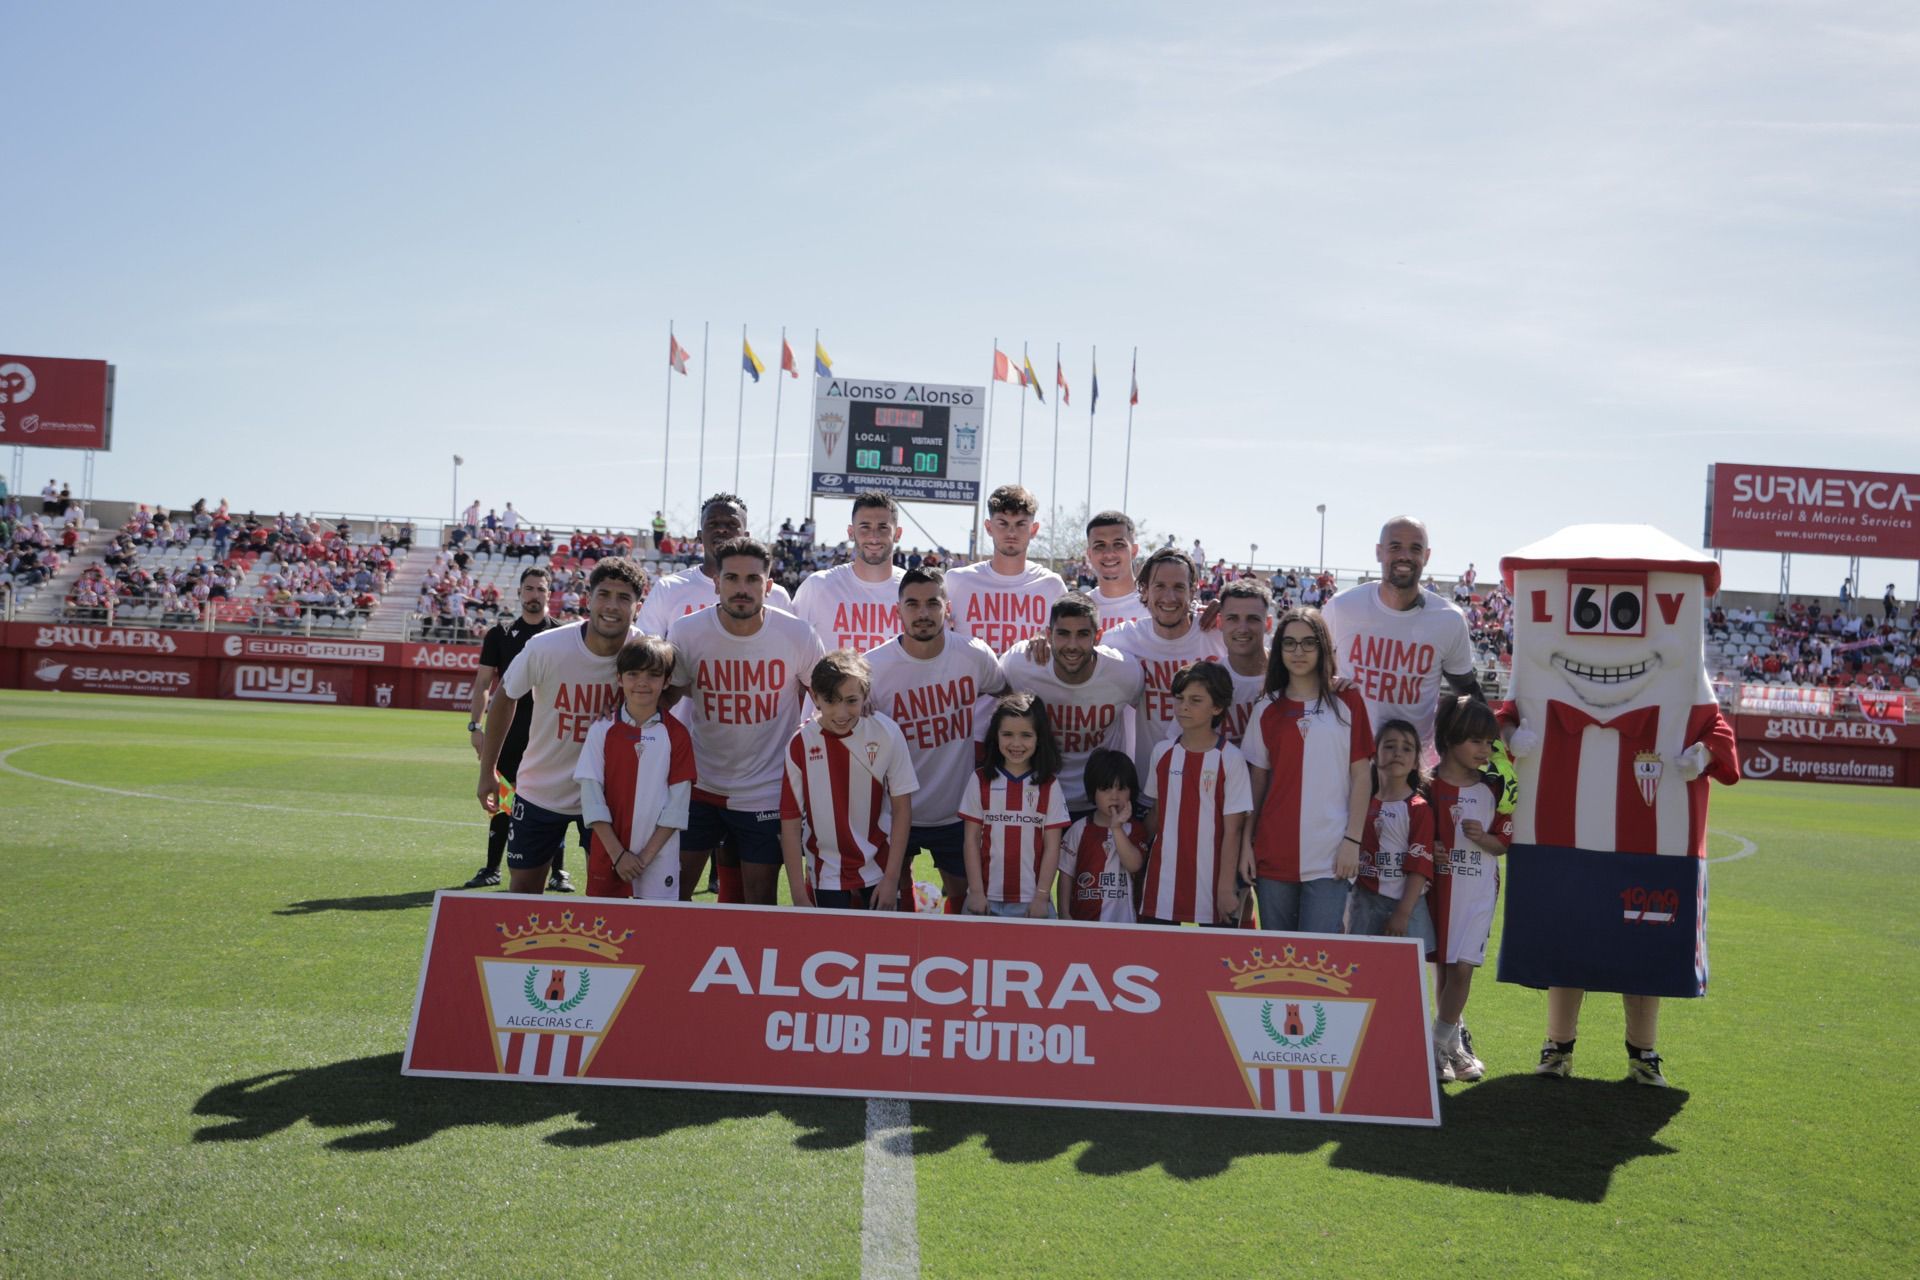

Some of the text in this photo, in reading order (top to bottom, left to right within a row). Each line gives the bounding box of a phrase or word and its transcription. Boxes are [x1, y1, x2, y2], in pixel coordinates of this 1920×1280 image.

[827, 381, 973, 405] Alonso Alonso
[855, 433, 887, 442] LOCAL
[911, 437, 943, 446] VISITANTE
[856, 449, 880, 469] 00
[880, 465, 912, 474] PERIODO
[914, 453, 938, 472] 00
[847, 476, 900, 486] PERMOTOR
[902, 480, 955, 489] ALGECIRAS
[894, 488, 926, 497] OFICIAL
[1733, 474, 1920, 512] SURMEYCA
[1732, 507, 1912, 528] Industrial & Marine Services
[1775, 531, 1877, 543] www.surmeyca.com
[833, 602, 905, 634] ANIM
[966, 593, 1046, 624] ANIMO
[414, 647, 480, 669] Adecc
[1349, 634, 1435, 674] ANIMO
[72, 667, 190, 686] SEA&PORTS
[697, 659, 785, 691] ANIMO
[1353, 665, 1424, 705] FERNI
[554, 683, 624, 713] ANIM
[703, 692, 779, 725] FERNI
[893, 675, 975, 721] ANIMO
[900, 707, 972, 749] FERNI
[1046, 704, 1115, 731] NIMO
[1783, 757, 1894, 778] Expressreformas
[689, 946, 1161, 1014] ALGECIRAS
[506, 1016, 594, 1030] ALGECIRAS C.F.
[766, 1006, 1095, 1065] CLUB DE FÚTBOL
[1252, 1050, 1340, 1065] ALGECIRAS C.F.
